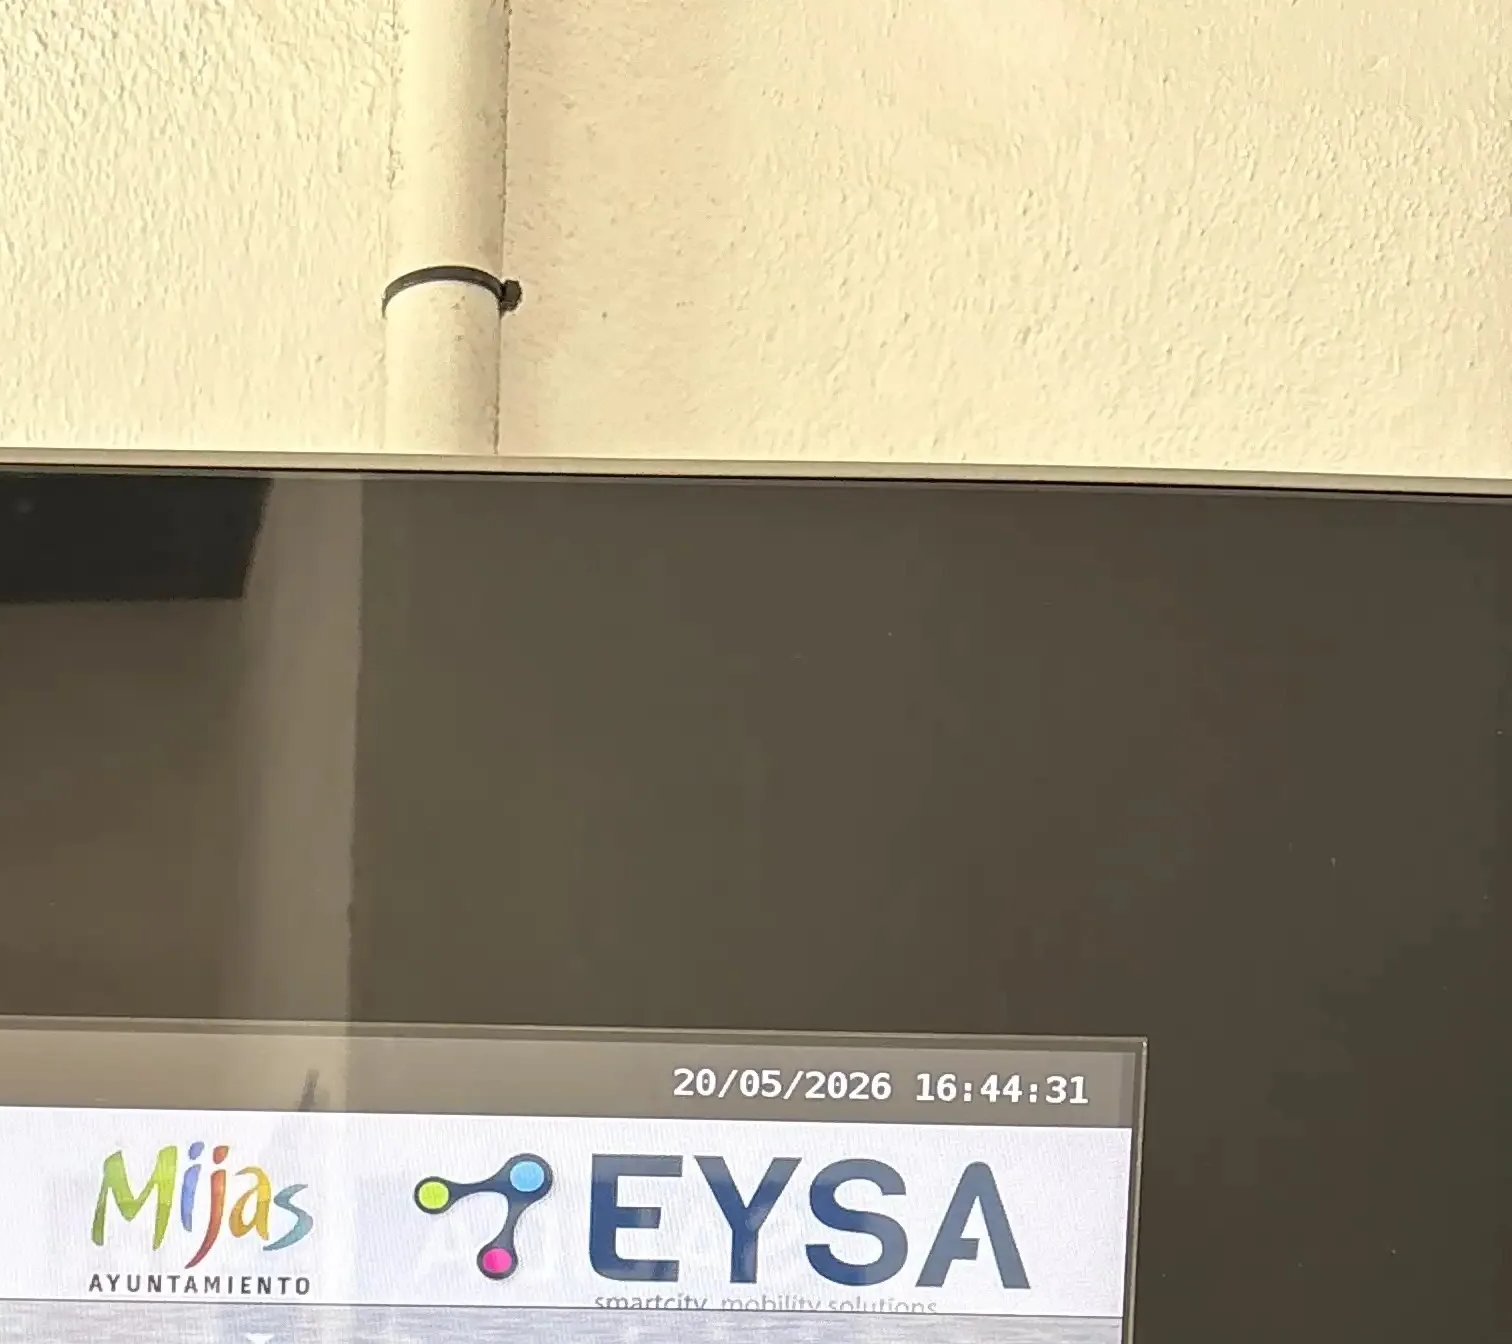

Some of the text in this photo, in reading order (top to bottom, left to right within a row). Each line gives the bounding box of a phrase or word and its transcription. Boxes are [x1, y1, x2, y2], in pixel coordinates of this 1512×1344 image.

[671, 1066, 1089, 1106] 20/05/2026 16:44:31
[90, 1141, 315, 1268] Mijas
[588, 1152, 1032, 1290] EYSA
[88, 1273, 311, 1296] AYUNTAMIENTO
[721, 1293, 821, 1312] mobility
[828, 1295, 937, 1313] solutions
